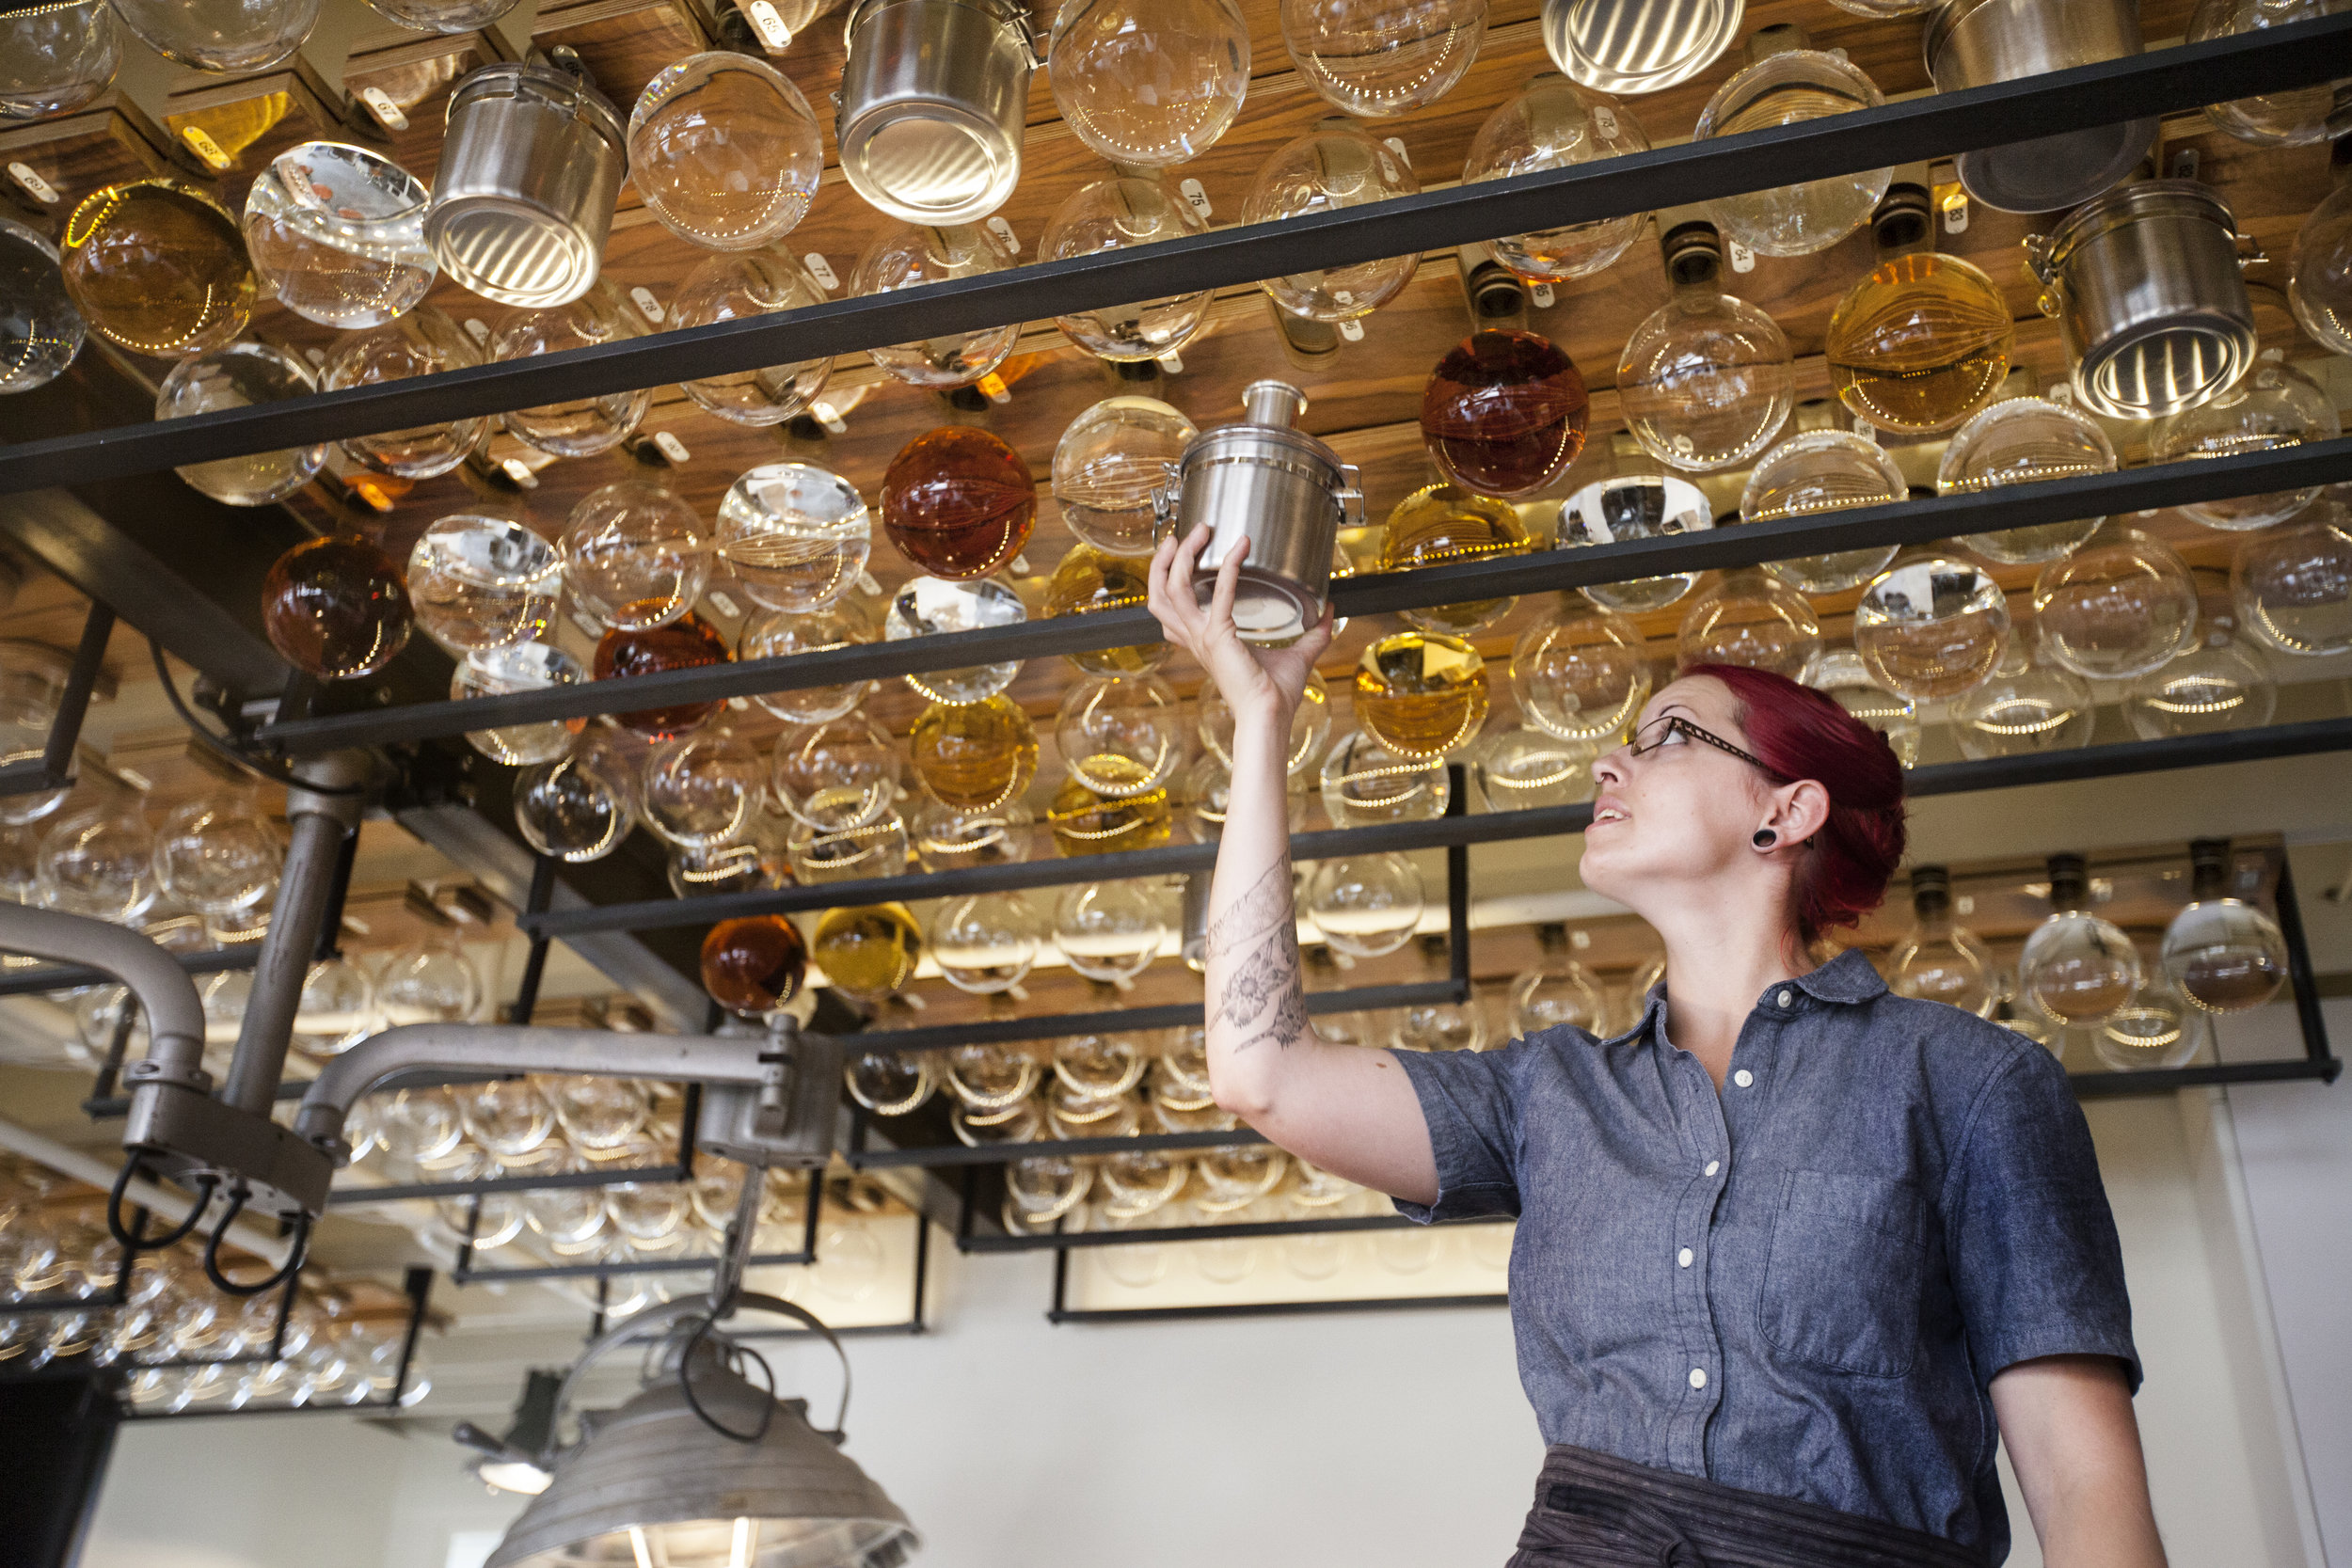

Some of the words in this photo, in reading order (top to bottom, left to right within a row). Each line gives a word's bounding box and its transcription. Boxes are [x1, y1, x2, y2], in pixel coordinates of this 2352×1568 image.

[762, 17, 778, 33] 65
[377, 103, 397, 116] 67
[199, 140, 218, 155] 68
[24, 176, 44, 191] 69
[1189, 192, 1205, 207] 75
[1949, 208, 1963, 222] 83
[997, 230, 1011, 243] 76
[814, 265, 831, 277] 77
[1534, 284, 1550, 297] 85
[641, 299, 658, 312] 78
